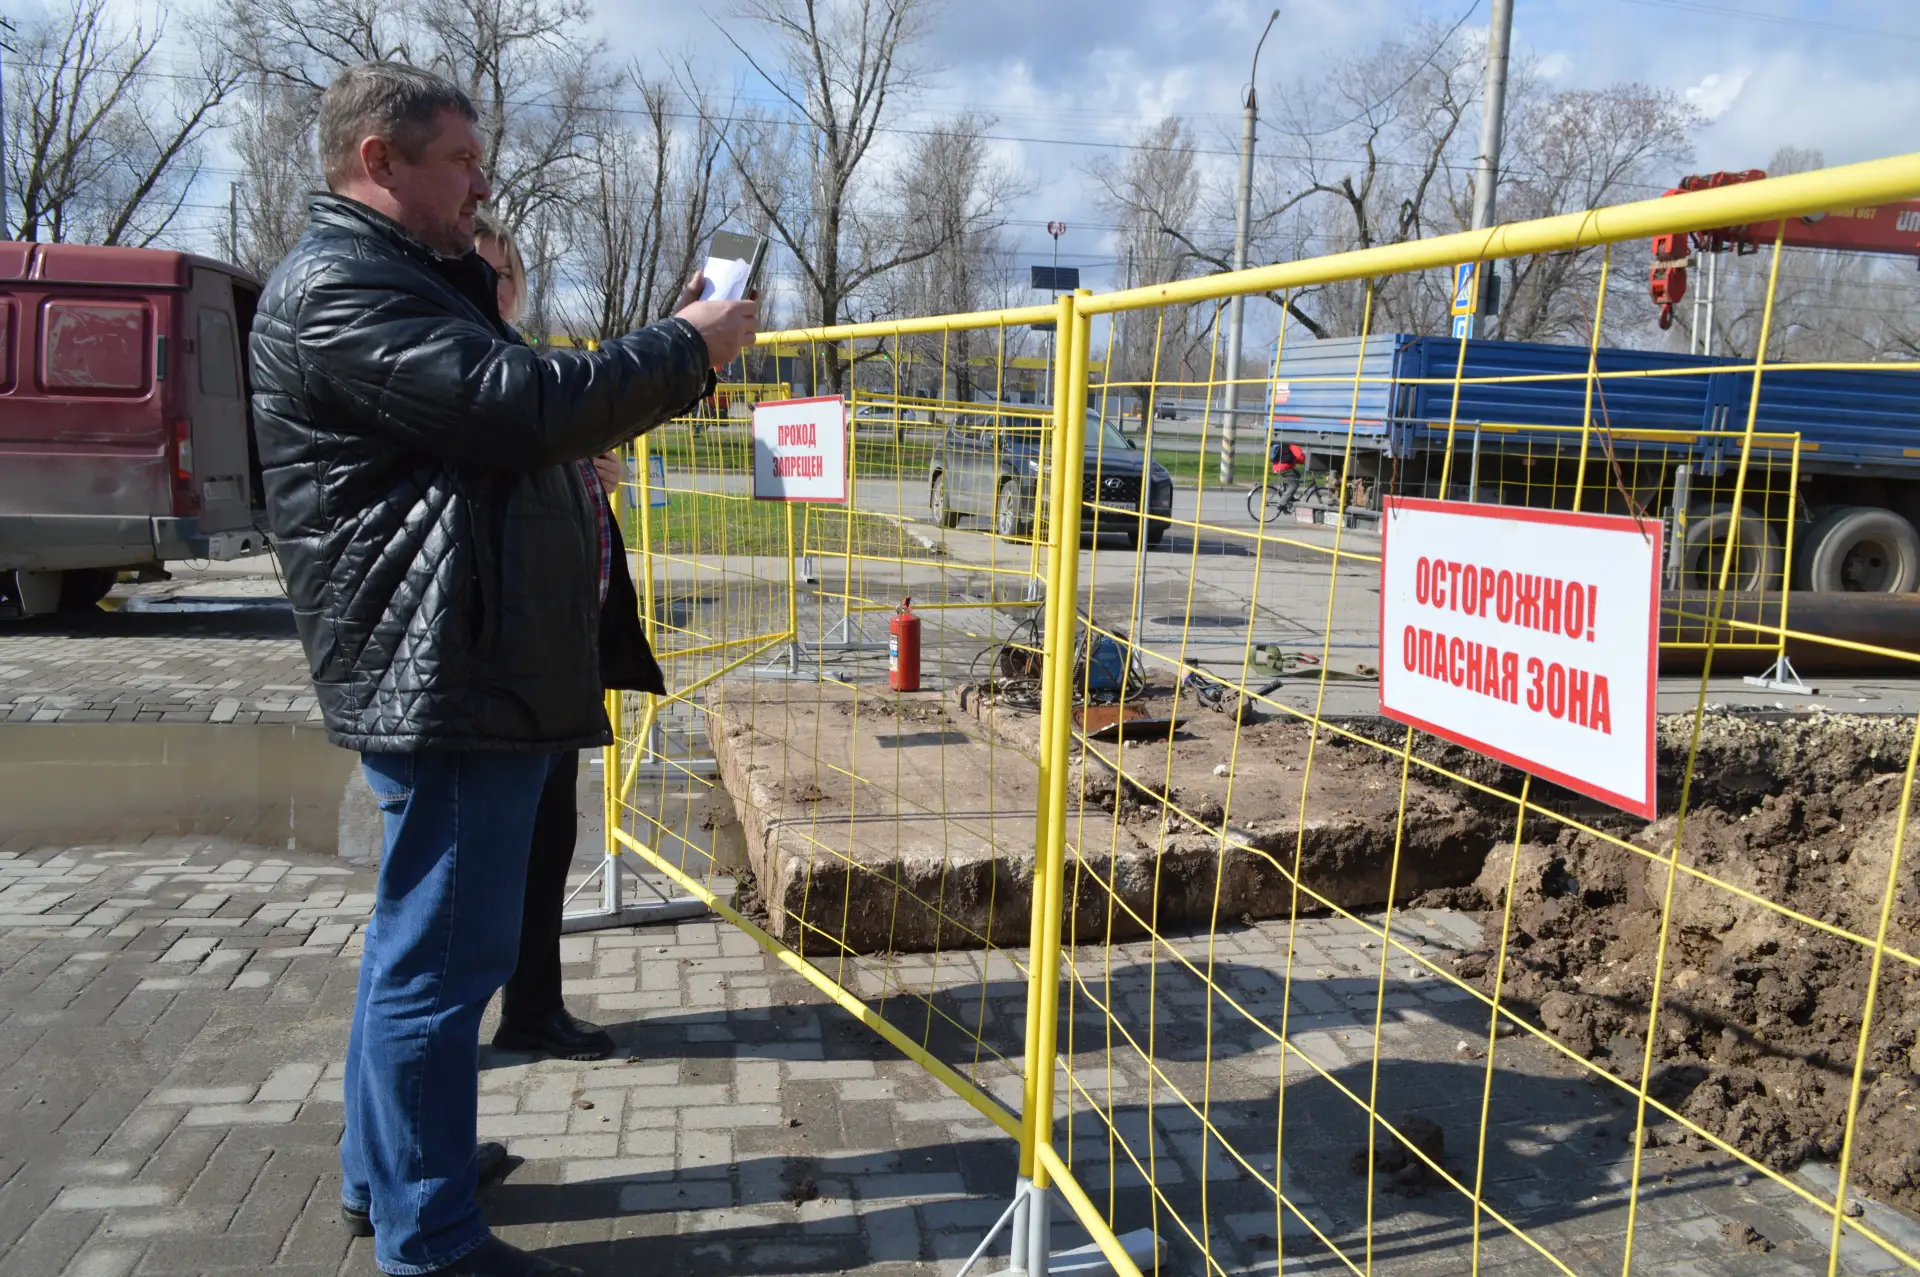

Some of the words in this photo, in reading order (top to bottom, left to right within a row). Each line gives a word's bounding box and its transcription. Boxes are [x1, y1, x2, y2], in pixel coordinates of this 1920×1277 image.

[777, 423, 817, 448] ПРОХОД
[772, 455, 823, 480] ЗАПРЕЩЕН
[1415, 556, 1598, 643] ОСТОРОЖНО!
[1403, 625, 1519, 705] ОПАСНАЯ
[1526, 657, 1612, 735] ЗОНА
